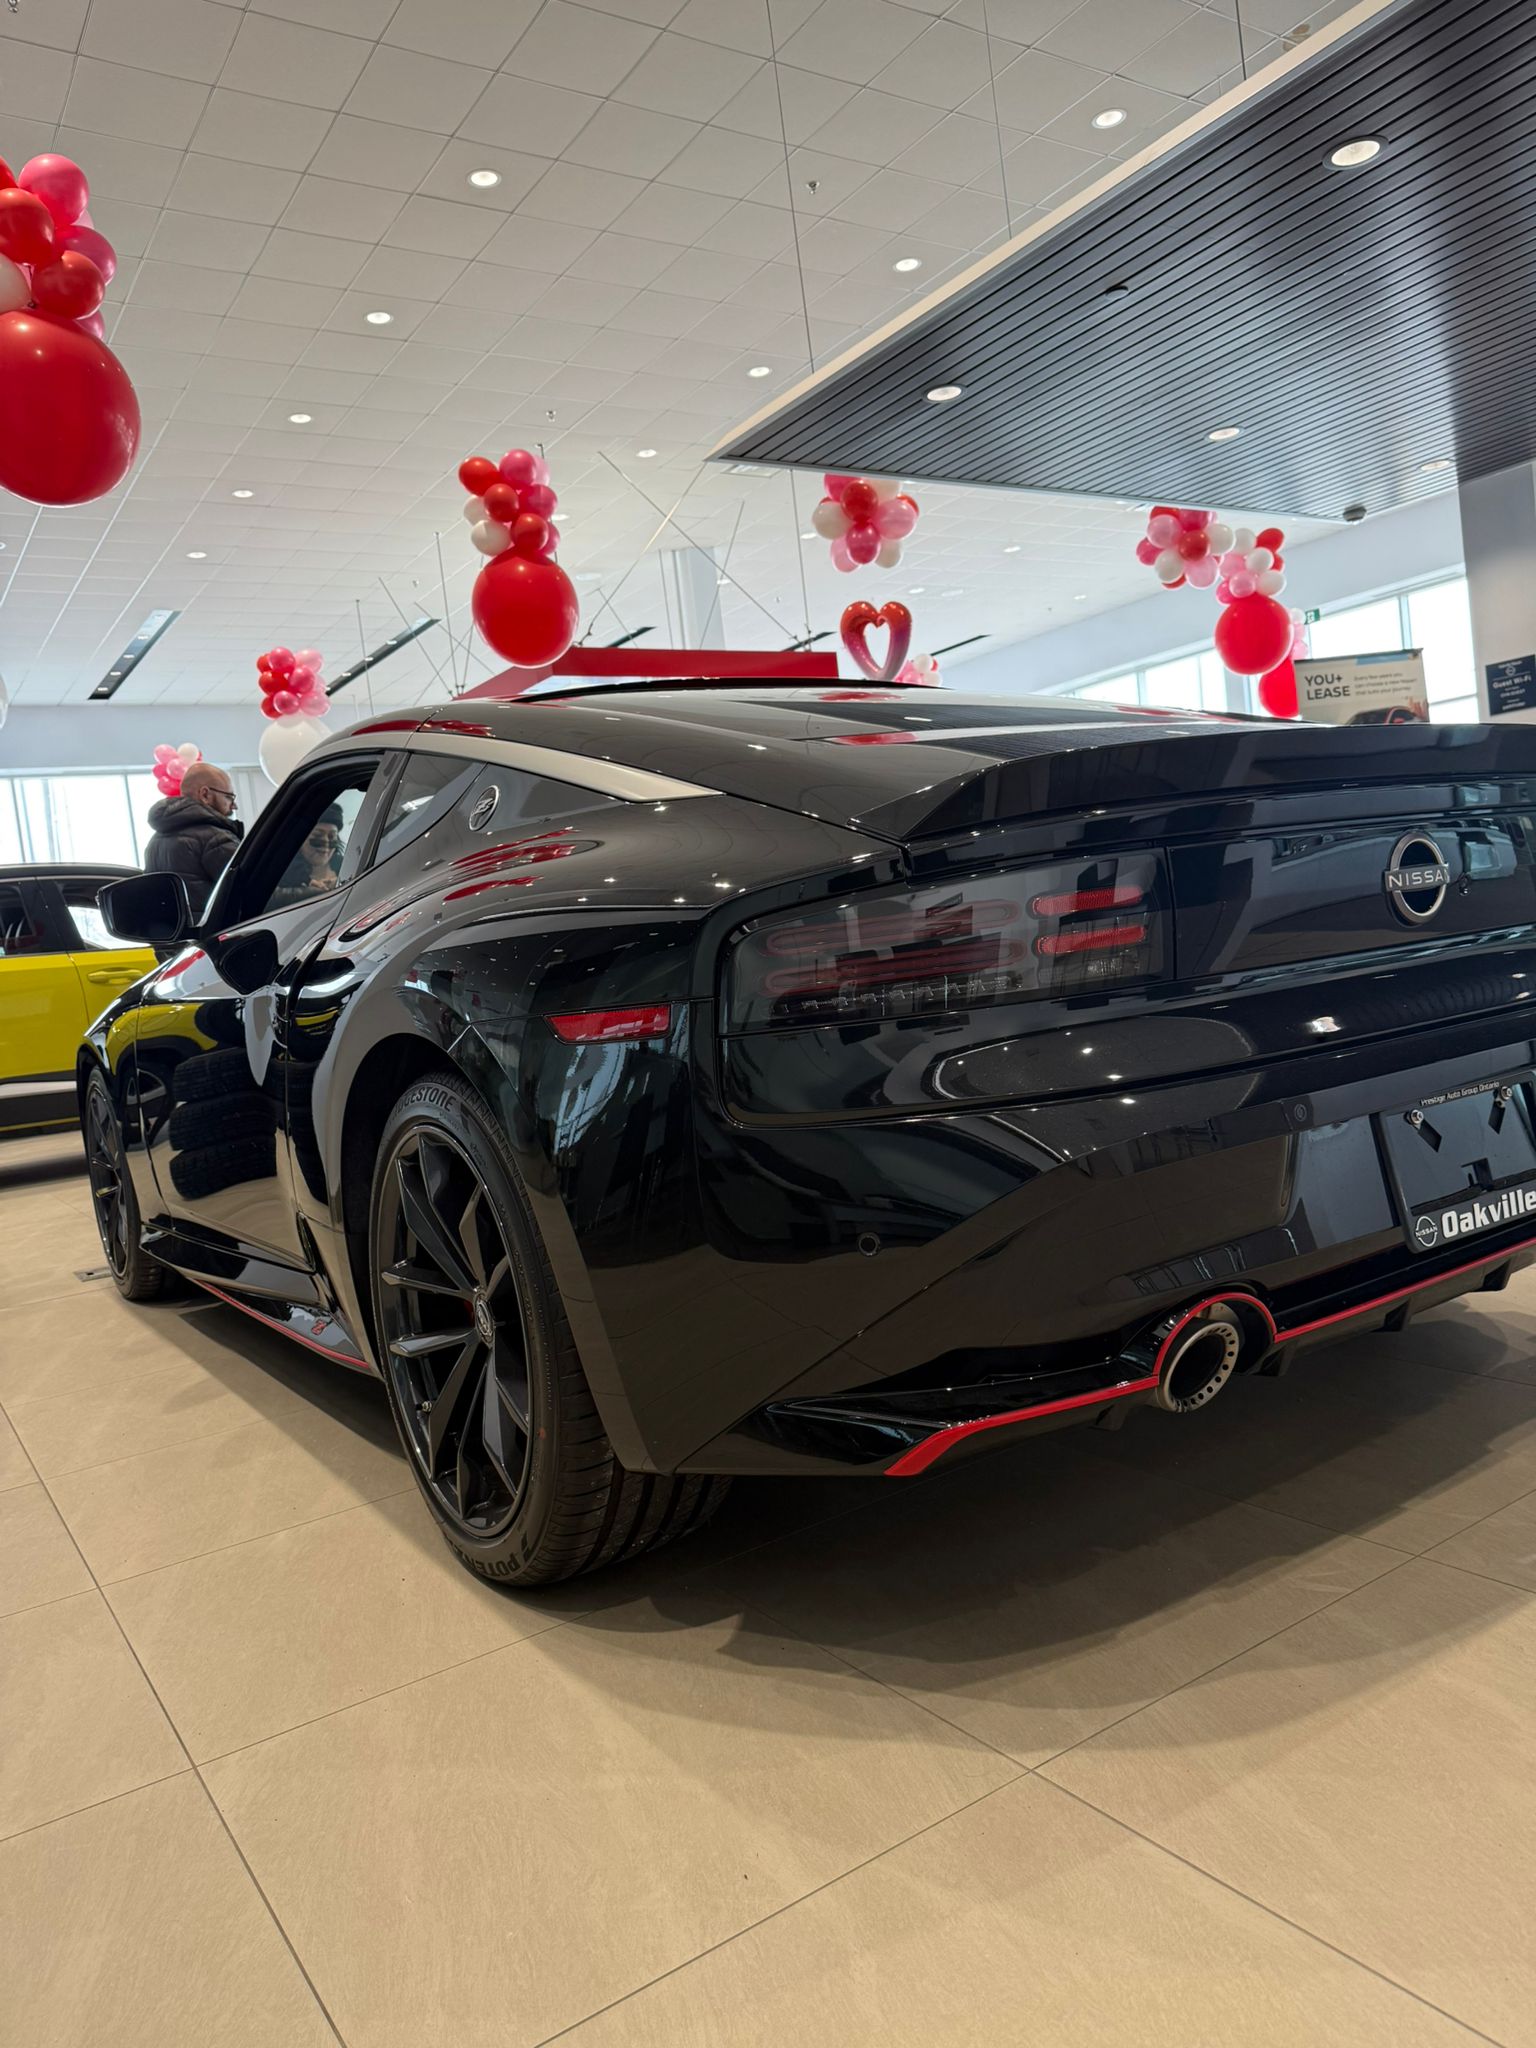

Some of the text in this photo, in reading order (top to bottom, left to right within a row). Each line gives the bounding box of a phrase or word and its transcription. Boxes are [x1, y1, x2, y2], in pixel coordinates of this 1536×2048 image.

[1304, 673, 1343, 687] YOU+
[1492, 679, 1512, 689] Guest
[1513, 675, 1532, 685] Wi-Fi
[1307, 685, 1351, 700] LEASE
[1421, 1081, 1500, 1106] Prestige Auto Group Ontario
[1442, 1188, 1536, 1239] Oakville
[1416, 1226, 1438, 1238] NISSAN
